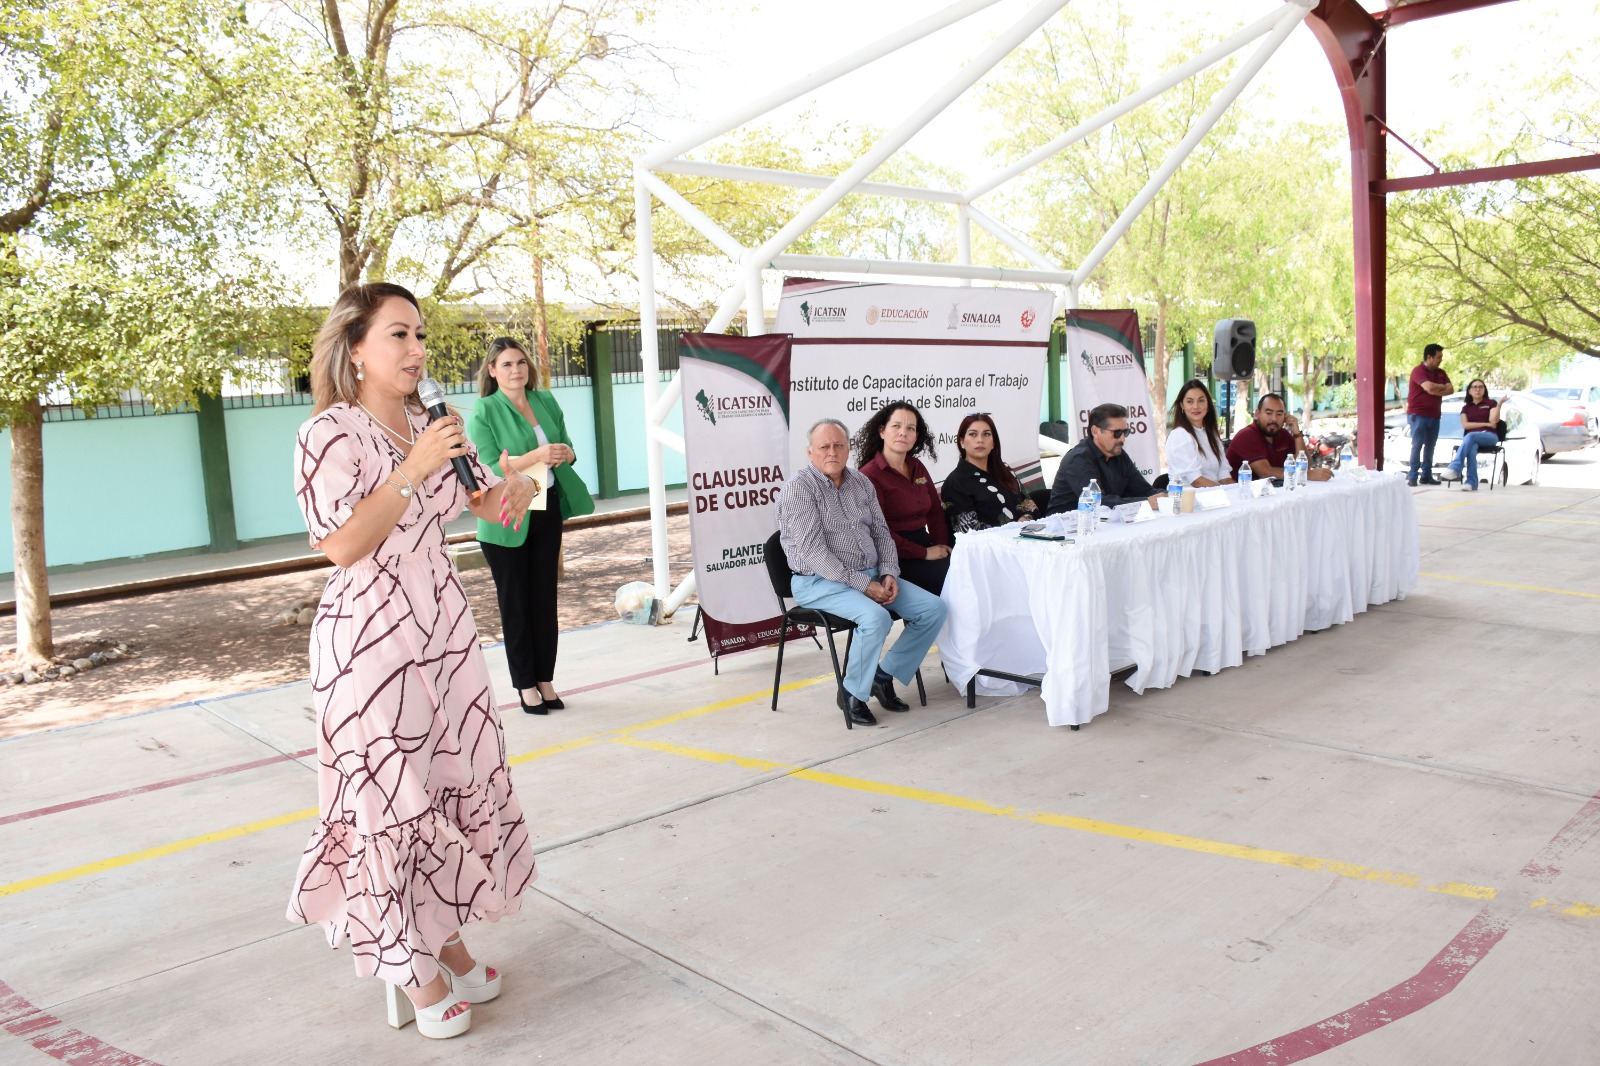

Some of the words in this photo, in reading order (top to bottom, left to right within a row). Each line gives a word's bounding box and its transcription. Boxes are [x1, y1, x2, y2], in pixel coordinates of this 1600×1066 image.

[814, 306, 847, 317] ICATSIN
[881, 307, 929, 319] EDUCACIÓN
[961, 312, 1001, 324] SINALOA
[1095, 354, 1133, 366] ICATSIN
[789, 376, 839, 392] nstituto
[842, 375, 859, 390] de
[862, 374, 943, 393] Capacitación
[946, 379, 972, 391] para
[975, 374, 985, 387] el
[988, 374, 1029, 390] Trabajo
[717, 395, 772, 411] ICATSIN
[847, 397, 867, 412] del
[916, 395, 931, 409] de
[934, 394, 976, 409] Sinaloa
[938, 432, 958, 445] Alva
[692, 464, 785, 491] CLAUSURA
[696, 493, 719, 514] DE
[706, 558, 747, 573] SALVADOR
[720, 635, 747, 647] SINALOA
